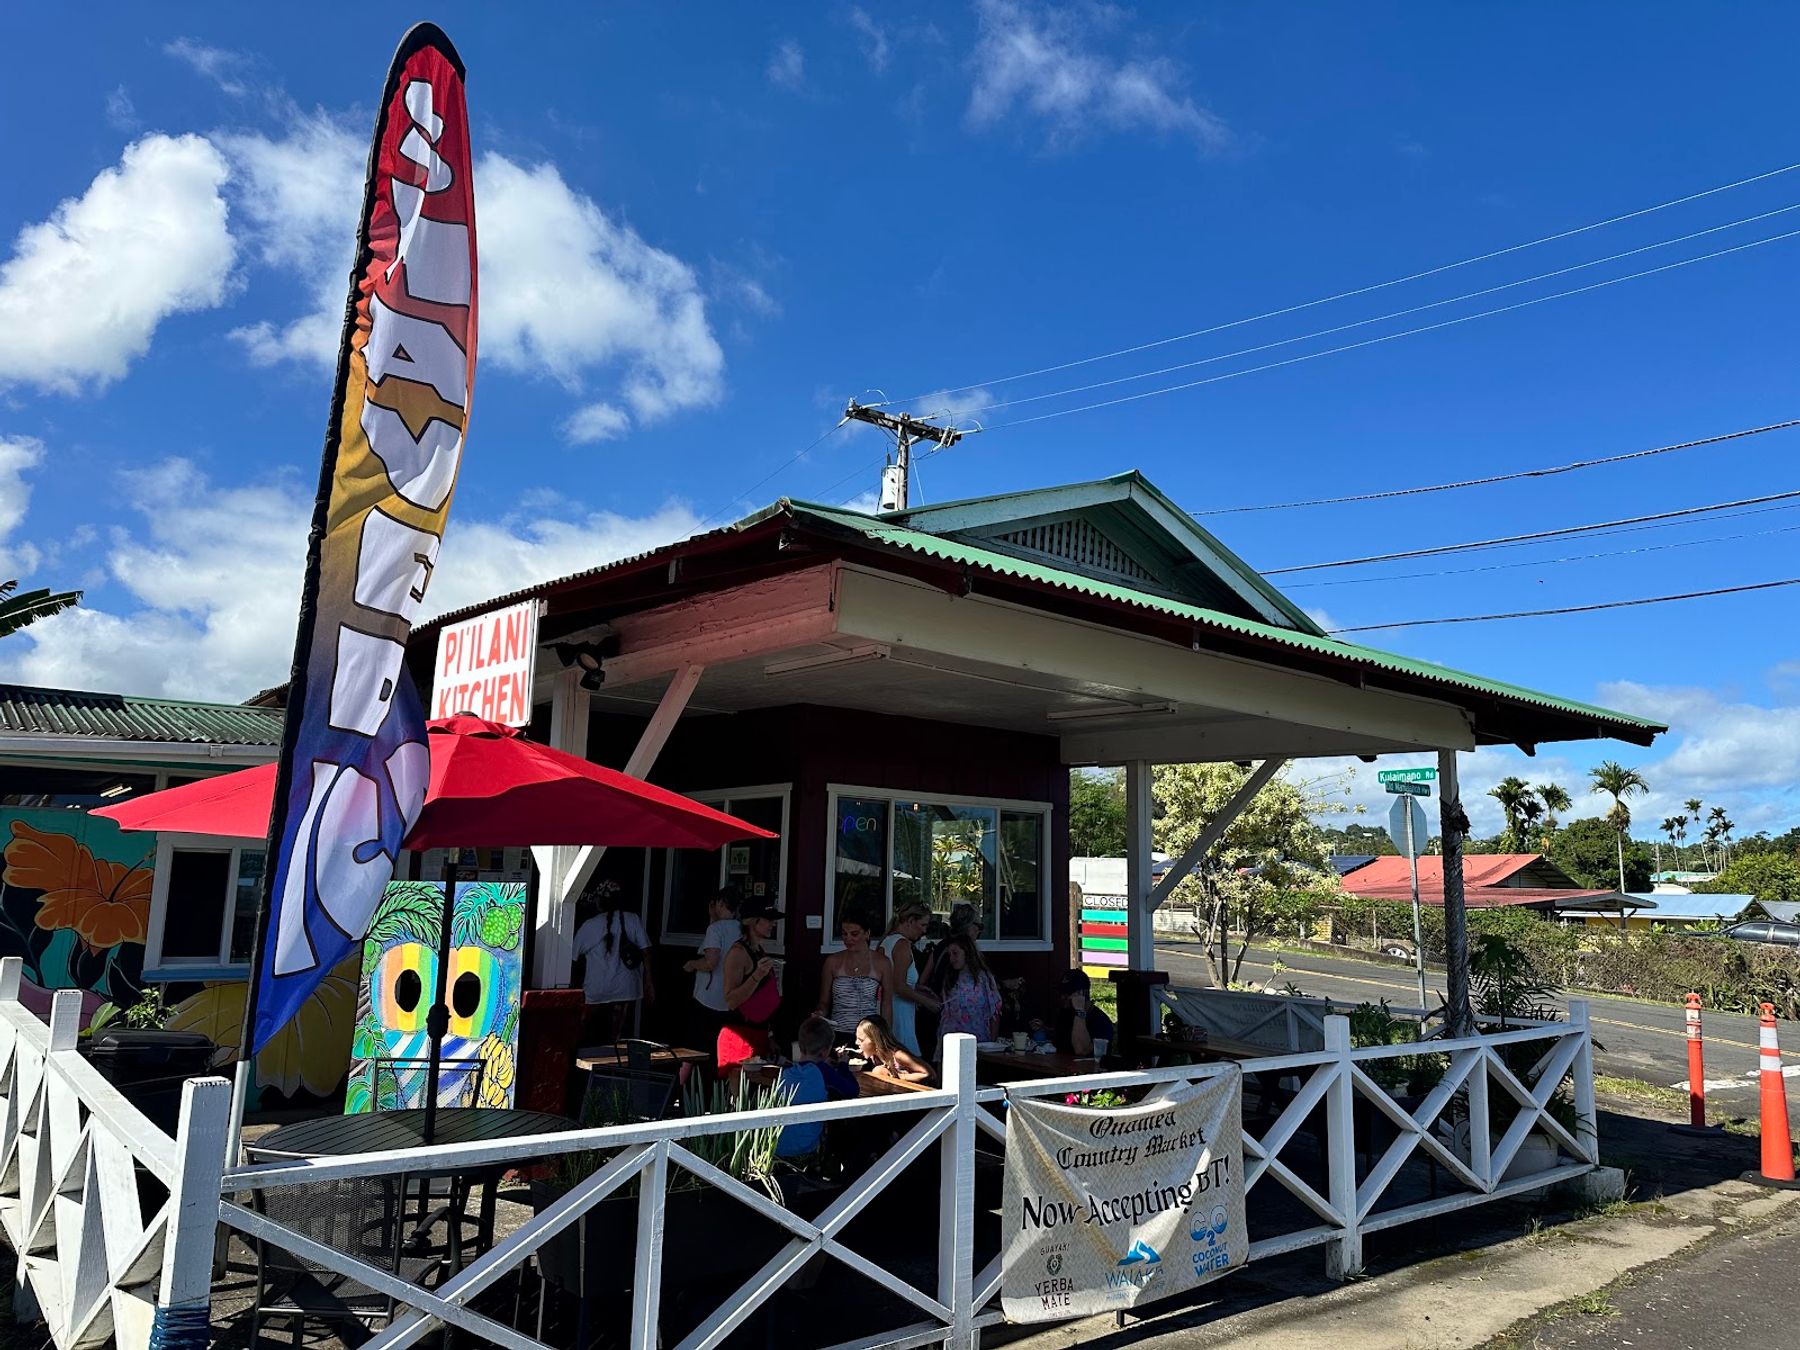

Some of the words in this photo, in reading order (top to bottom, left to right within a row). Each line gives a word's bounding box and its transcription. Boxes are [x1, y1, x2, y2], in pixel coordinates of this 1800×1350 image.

[438, 670, 527, 724] KITCHEN
[1379, 771, 1421, 782] Kulaimano
[1425, 771, 1434, 779] Rd
[1084, 896, 1129, 907] CLOSED
[1056, 1145, 1139, 1170] Country
[1144, 1126, 1207, 1157] Market
[1022, 1196, 1083, 1230] Now
[1083, 1180, 1193, 1226] Accepting
[1192, 1242, 1227, 1264] COCONUT
[1194, 1253, 1229, 1277] WATER
[1034, 1277, 1074, 1296] YERBA
[1040, 1292, 1071, 1310] MATE
